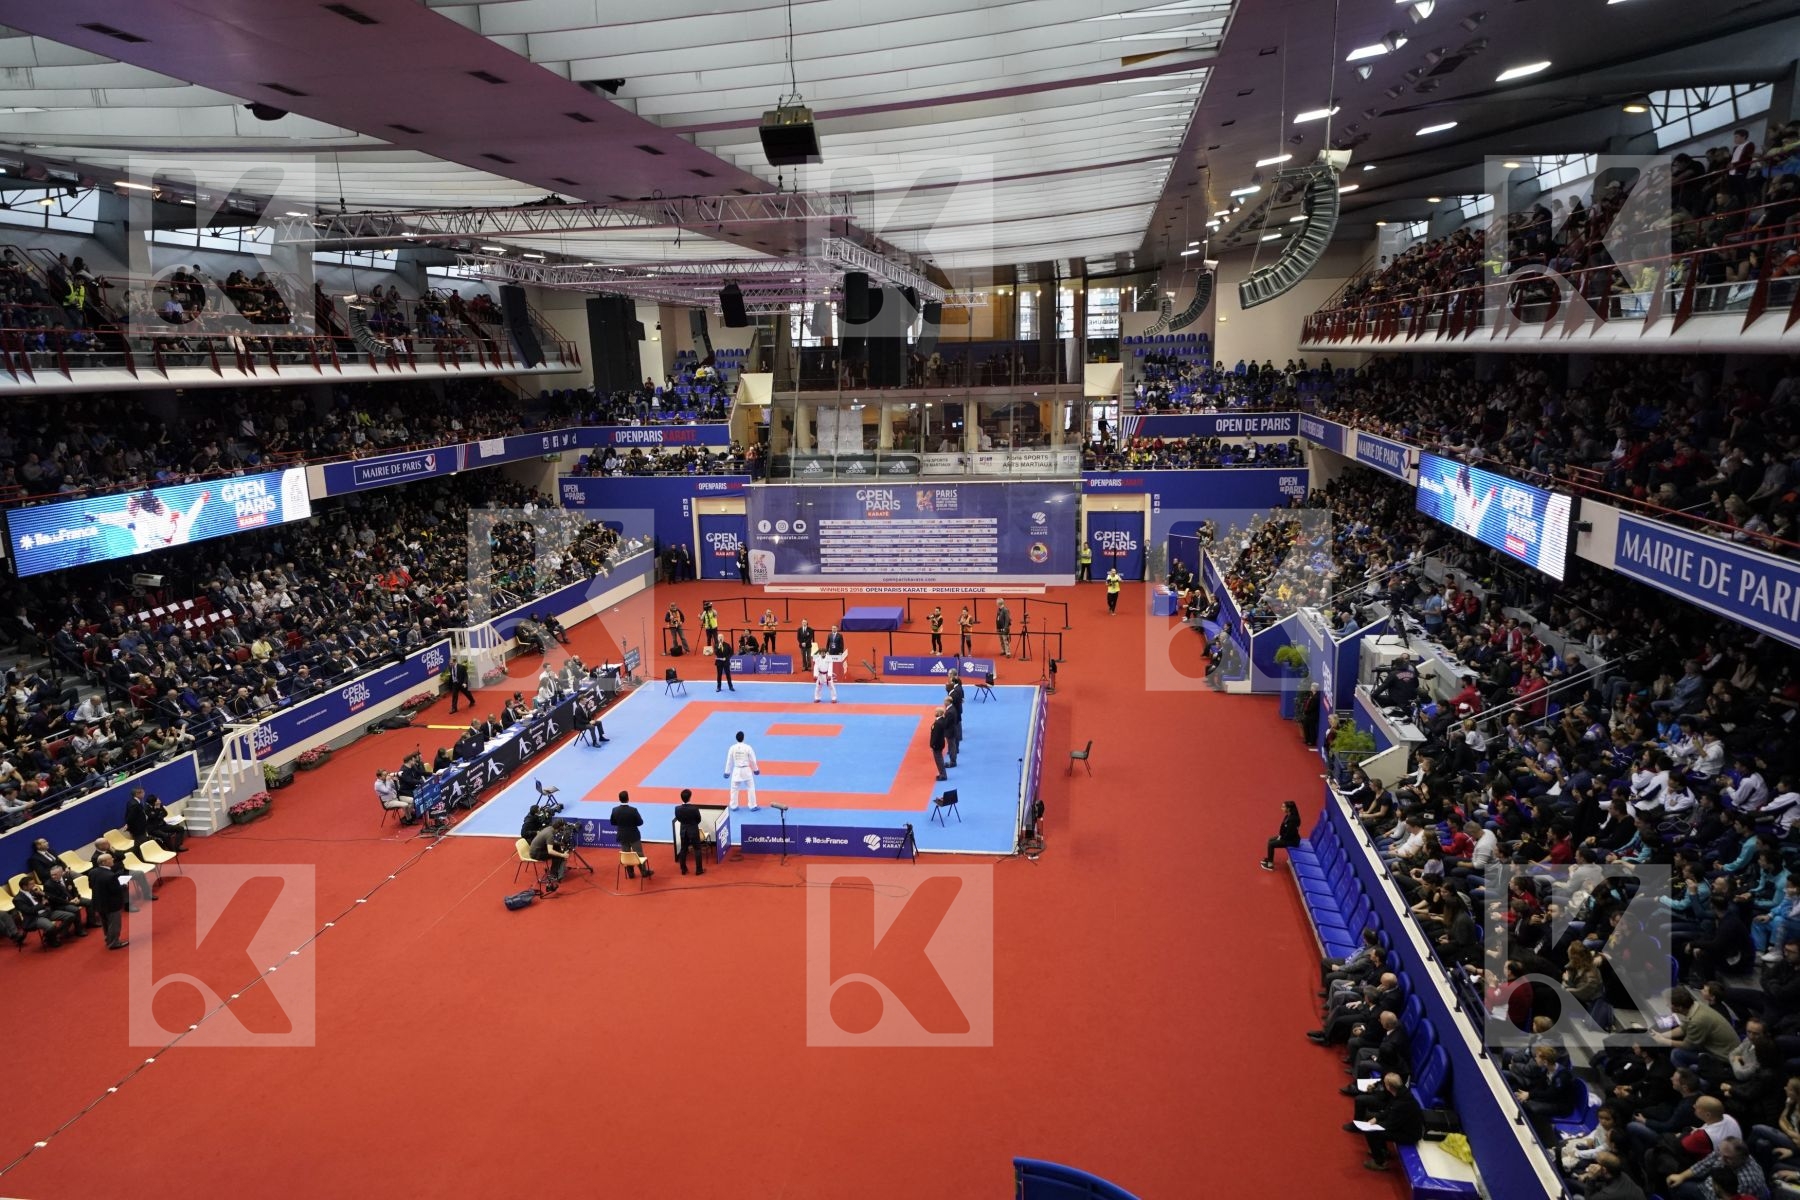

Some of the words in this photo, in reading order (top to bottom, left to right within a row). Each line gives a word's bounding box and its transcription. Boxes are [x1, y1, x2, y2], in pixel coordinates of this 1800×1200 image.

[1216, 418, 1242, 432] OPEN
[1244, 418, 1258, 432] DE
[1260, 417, 1291, 431] PARIS
[1359, 439, 1374, 458] MAIRIE
[1374, 445, 1382, 462] DE
[1383, 448, 1400, 468] PARIS
[362, 465, 390, 480] MAIRIE
[390, 464, 401, 474] DE
[402, 460, 422, 472] PARIS
[1279, 476, 1298, 486] OPEN
[222, 480, 266, 502] OPEN
[564, 484, 578, 492] OPEN
[936, 489, 958, 498] PARIS
[1284, 486, 1306, 494] PARIS
[569, 492, 586, 500] PARIS
[856, 490, 892, 501] OPEN
[236, 494, 277, 517] PARIS
[866, 500, 901, 510] PARIS
[706, 532, 737, 542] OPEN
[1094, 531, 1130, 541] OPEN
[714, 542, 743, 551] PARIS
[1102, 541, 1138, 550] PARIS
[1622, 530, 1695, 582] MAIRIE
[1698, 556, 1732, 596] DE
[1738, 569, 1800, 622] PARI
[421, 648, 440, 664] OPEN
[427, 654, 444, 670] PARIS
[342, 682, 365, 700] OPEN
[349, 688, 370, 706] PARIS
